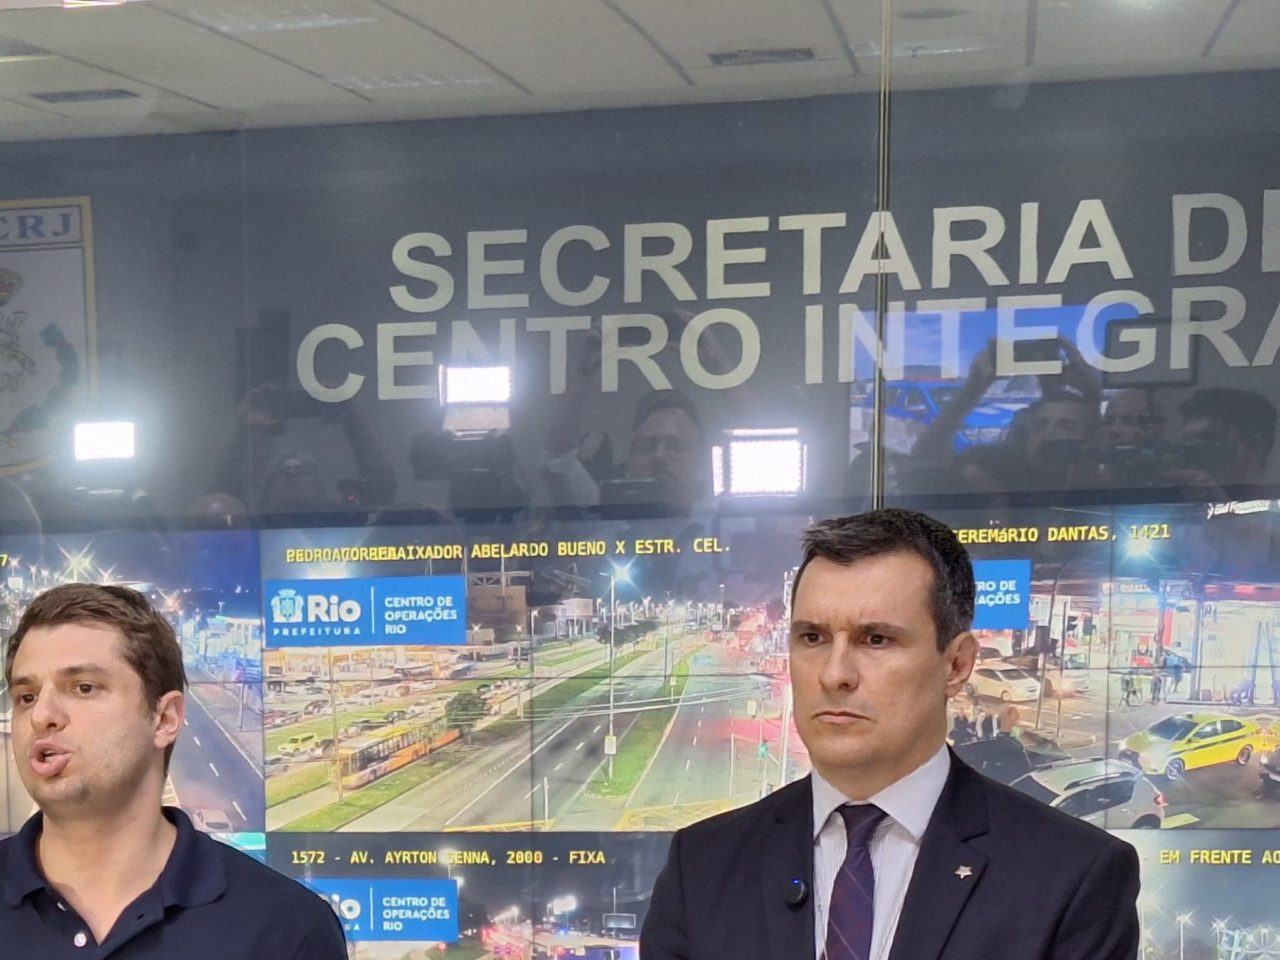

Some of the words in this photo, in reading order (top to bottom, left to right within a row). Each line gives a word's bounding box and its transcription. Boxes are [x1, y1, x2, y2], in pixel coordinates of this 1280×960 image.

[389, 198, 1133, 314] SECRETARIA
[1173, 190, 1280, 277] D
[296, 306, 761, 404] CENTRO
[952, 527, 1038, 544] EREMáRIO
[1130, 523, 1171, 540] 1421
[471, 542, 549, 558] ABELARDO
[557, 540, 606, 556] BUENO
[615, 540, 626, 554] X
[635, 539, 682, 554] ESTR.
[693, 537, 731, 552] CEL.
[999, 580, 1017, 591] DE
[307, 594, 362, 623] Rio
[384, 596, 433, 608] CENTRO
[436, 595, 453, 607] DE
[384, 609, 458, 623] OPERAÇÕES
[273, 626, 361, 636] PREFEITURA
[384, 624, 407, 635] RIO
[291, 850, 325, 864] 1572
[350, 850, 375, 864] AV.
[385, 850, 437, 864] AYRTON
[506, 850, 543, 864] 2000
[569, 850, 606, 864] FIXA
[1159, 849, 1180, 864] EM
[1190, 849, 1252, 864] FRENTE
[382, 896, 428, 907] CENTRO
[430, 896, 446, 907] DE
[382, 907, 450, 921] OPERAÇÕES
[382, 921, 403, 931] RIO
